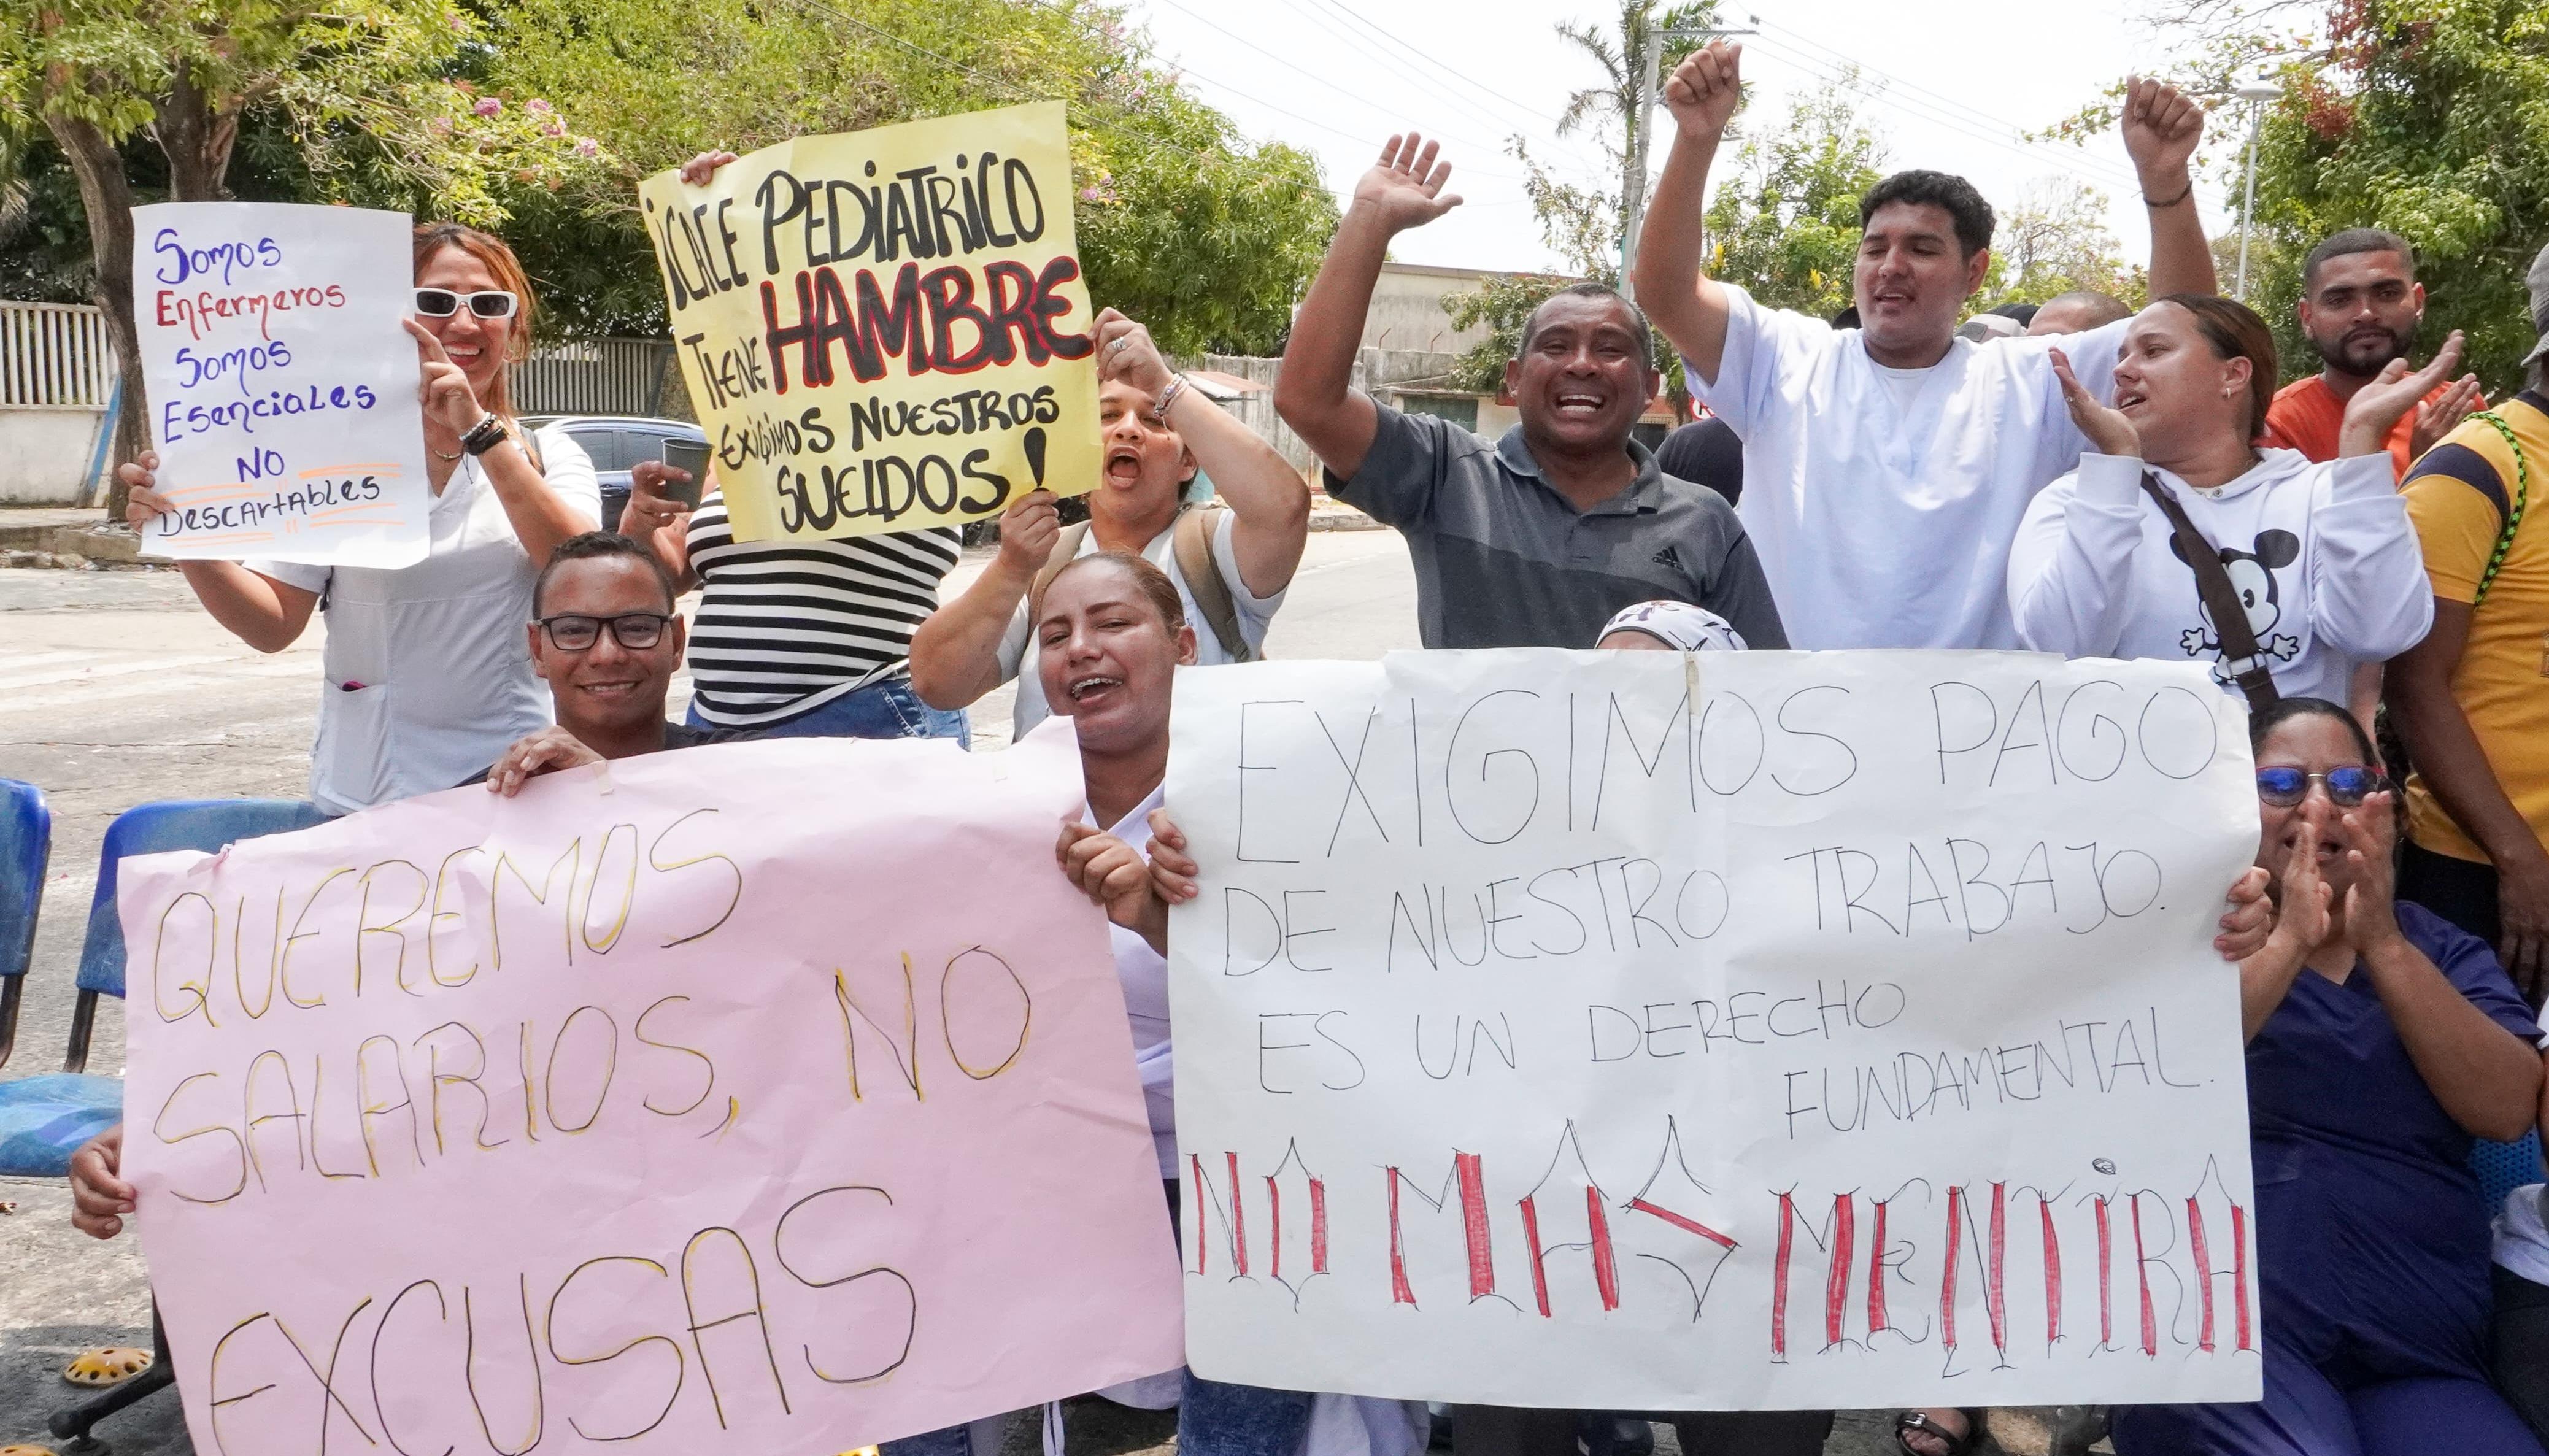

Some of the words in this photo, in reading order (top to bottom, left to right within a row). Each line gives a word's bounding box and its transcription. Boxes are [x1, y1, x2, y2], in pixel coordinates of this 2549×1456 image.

[155, 228, 281, 285] Somos
[760, 256, 1095, 395] HAMBRE
[176, 341, 291, 396] Somos
[850, 385, 1060, 453] NUESTROS
[237, 447, 285, 482] NO
[1237, 686, 1857, 863] EXIGIMOS
[1931, 680, 2217, 787] PAGO
[155, 809, 742, 1028] QUEREMOS
[1225, 888, 1336, 976] DE
[1389, 857, 1729, 973] NUESTRO
[1784, 837, 2165, 942] TRABAJO.
[153, 996, 739, 1203] SALARIOS,
[835, 944, 1032, 1103] NO
[1259, 1010, 1365, 1093] ES
[1417, 1012, 1515, 1079] UN
[1589, 980, 1905, 1061] DERECHO
[1784, 1007, 2215, 1139] FUNDAMENTAL.
[1185, 1136, 1330, 1312] NO
[1373, 1114, 1742, 1323] MAS
[210, 1186, 916, 1456] EXCUSAS
